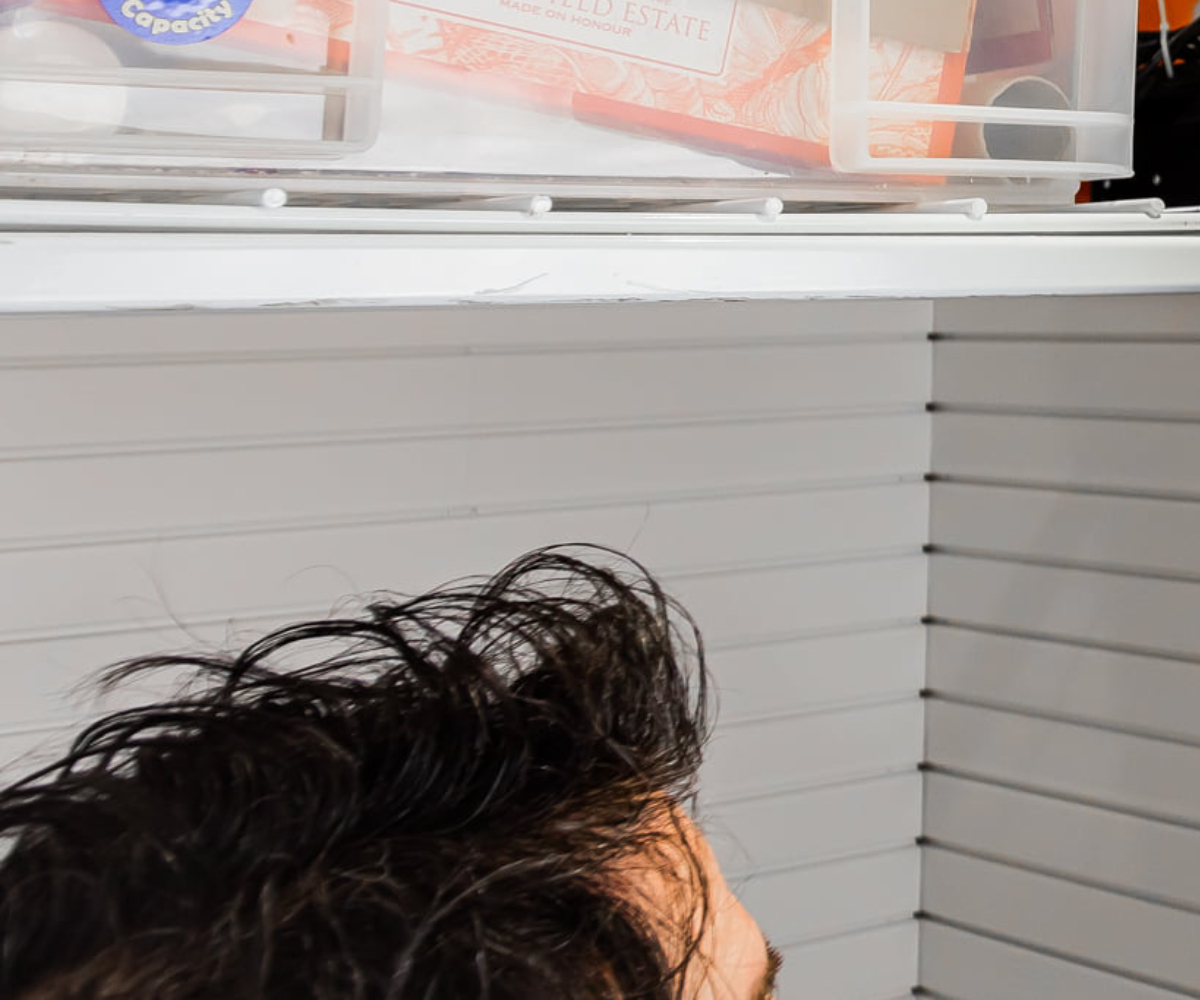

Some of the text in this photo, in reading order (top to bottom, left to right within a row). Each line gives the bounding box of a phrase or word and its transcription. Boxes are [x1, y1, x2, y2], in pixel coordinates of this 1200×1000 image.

[545, 8, 567, 22] ON
[570, 14, 634, 38] HONOUR
[622, 0, 711, 42] ESTATE
